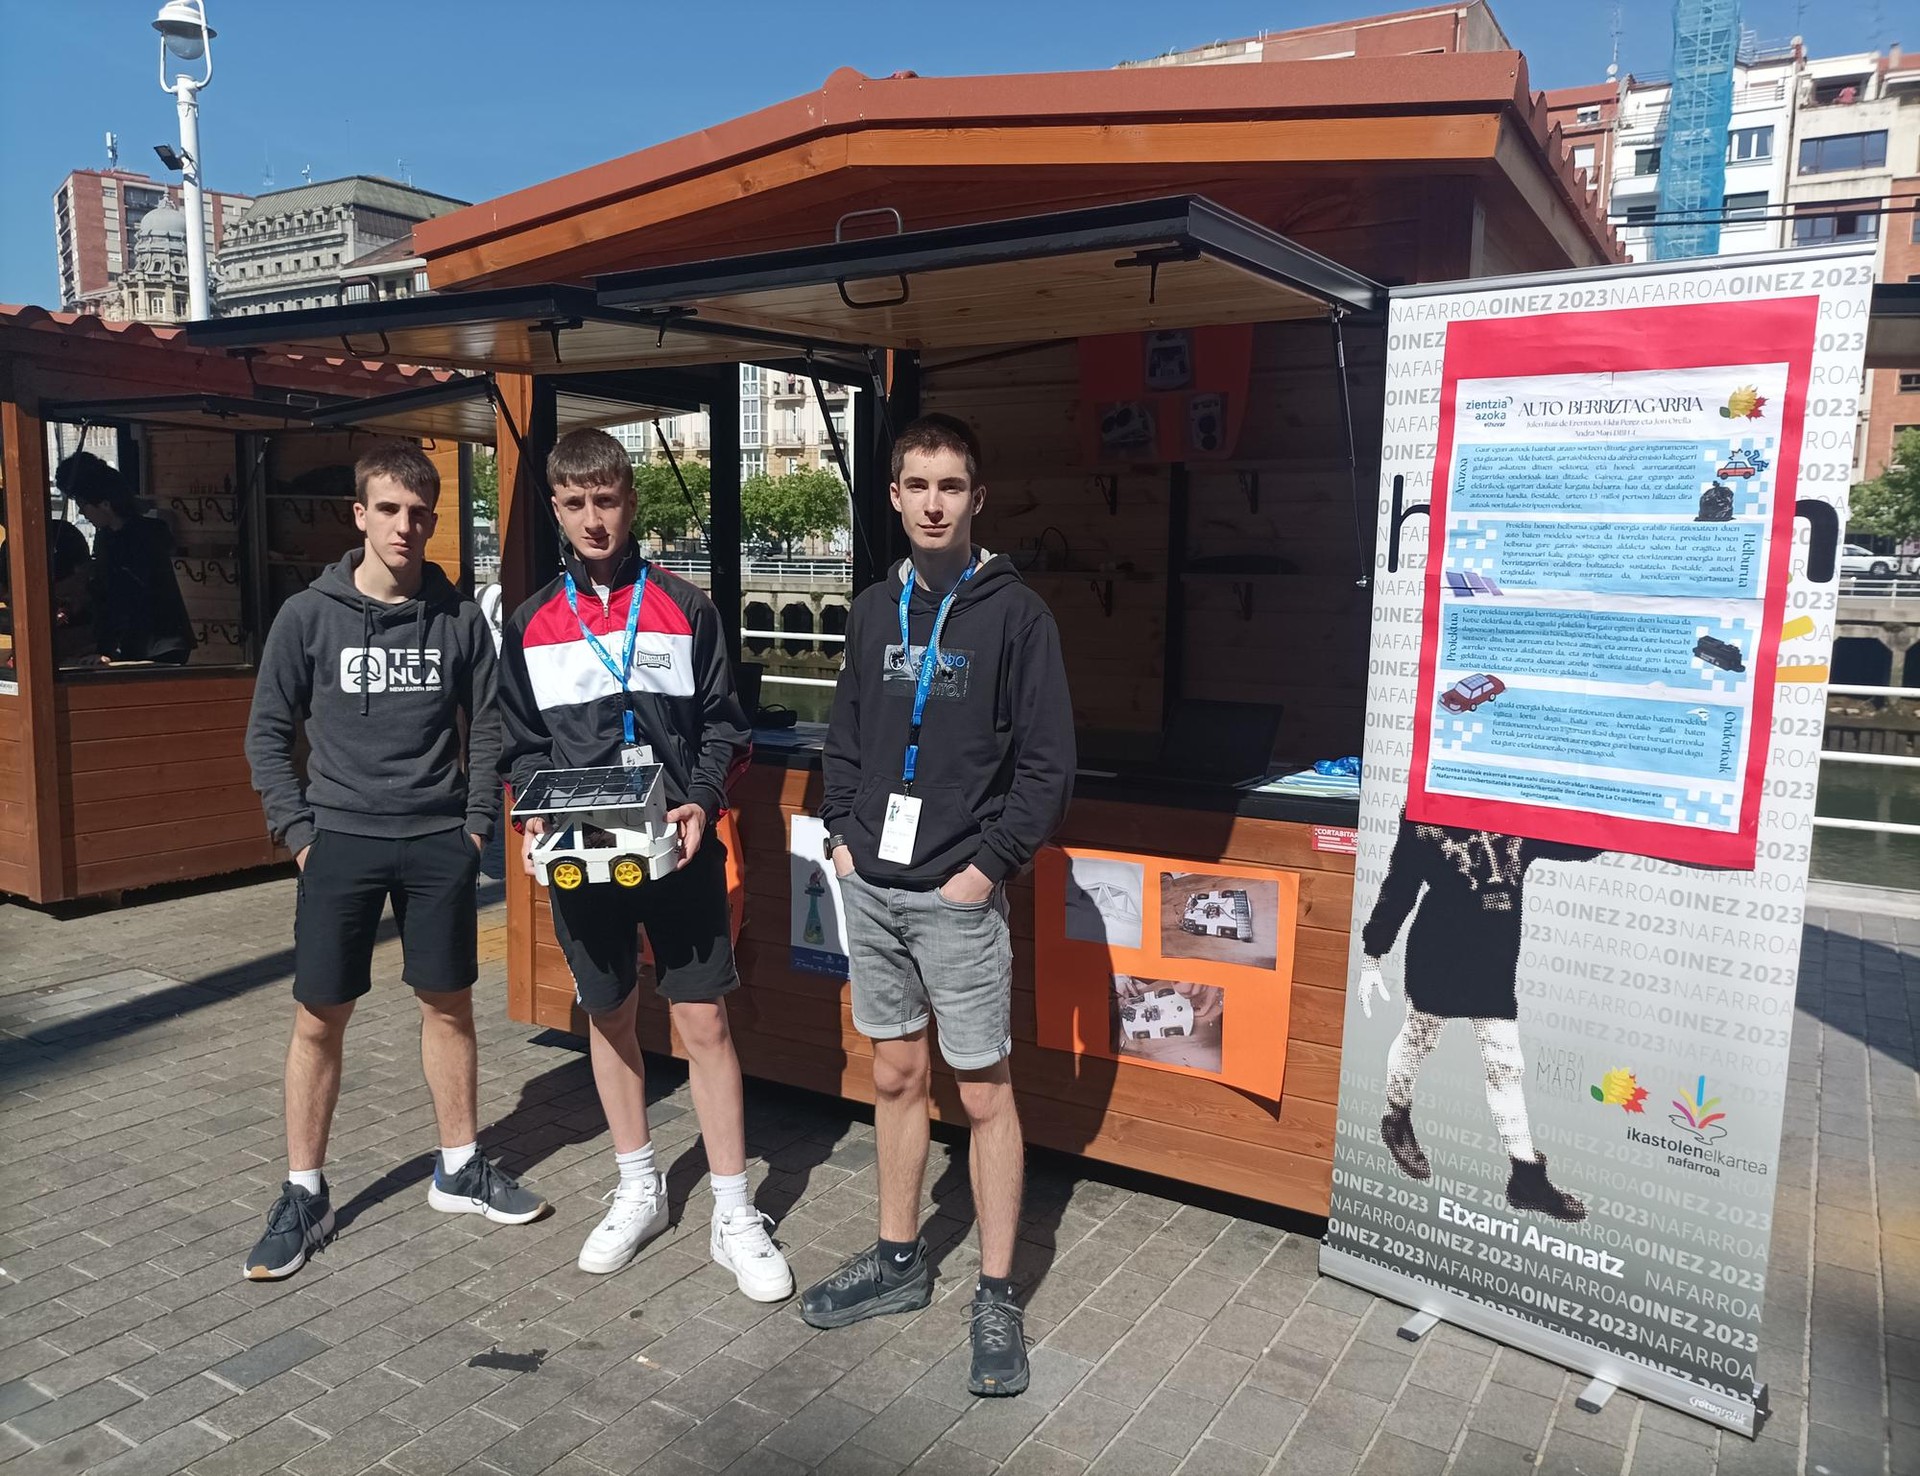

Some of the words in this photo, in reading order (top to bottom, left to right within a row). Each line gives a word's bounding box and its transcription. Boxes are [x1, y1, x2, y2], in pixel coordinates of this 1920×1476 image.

[1558, 289, 1607, 309] 2023
[1811, 266, 1872, 289] 2023
[1388, 332, 1445, 351] OINEZ
[1466, 399, 1507, 410] zientzia
[1475, 411, 1507, 420] azoka
[1518, 400, 1564, 417] AUTO
[1455, 457, 1468, 495] Arazoa
[389, 648, 442, 666] TER
[1719, 711, 1737, 774] Ondorioak
[1556, 900, 1620, 926] OINEZ
[1626, 911, 1677, 936] 2023
[1669, 889, 1739, 916] OINEZ
[1746, 901, 1802, 925] 2023
[1551, 956, 1615, 984] OINEZ
[1621, 970, 1671, 995] 2023
[1664, 949, 1733, 977] OINEZ
[1740, 961, 1795, 986] 2023
[1658, 1007, 1728, 1037] OINEZ
[1734, 1022, 1789, 1049] 2023
[1536, 1061, 1582, 1092] MARI
[1667, 1155, 1720, 1178] nafarroa
[1332, 1168, 1384, 1199] OINEZ
[1387, 1186, 1429, 1213] 2023
[1438, 1197, 1518, 1243] Etxarri
[1522, 1226, 1625, 1278] Aranatz
[1330, 1193, 1417, 1237] NAFARROA
[1417, 1223, 1474, 1256] OINEZ
[1478, 1242, 1523, 1272] 2023
[1524, 1258, 1630, 1308] NAFARROA
[1629, 1294, 1699, 1333] OINEZ
[1704, 1319, 1759, 1352] 2023
[1635, 1238, 1704, 1274] OINEZ
[1708, 1260, 1765, 1291] 2023
[1328, 1217, 1380, 1249] OINEZ
[1383, 1237, 1425, 1265] 2023
[1425, 1252, 1522, 1299] NAFARROA
[1521, 1286, 1584, 1322] OINEZ
[1588, 1309, 1638, 1341] 2023
[1640, 1327, 1755, 1382] NAFARROA
[1646, 1270, 1763, 1324] NAFARROA
